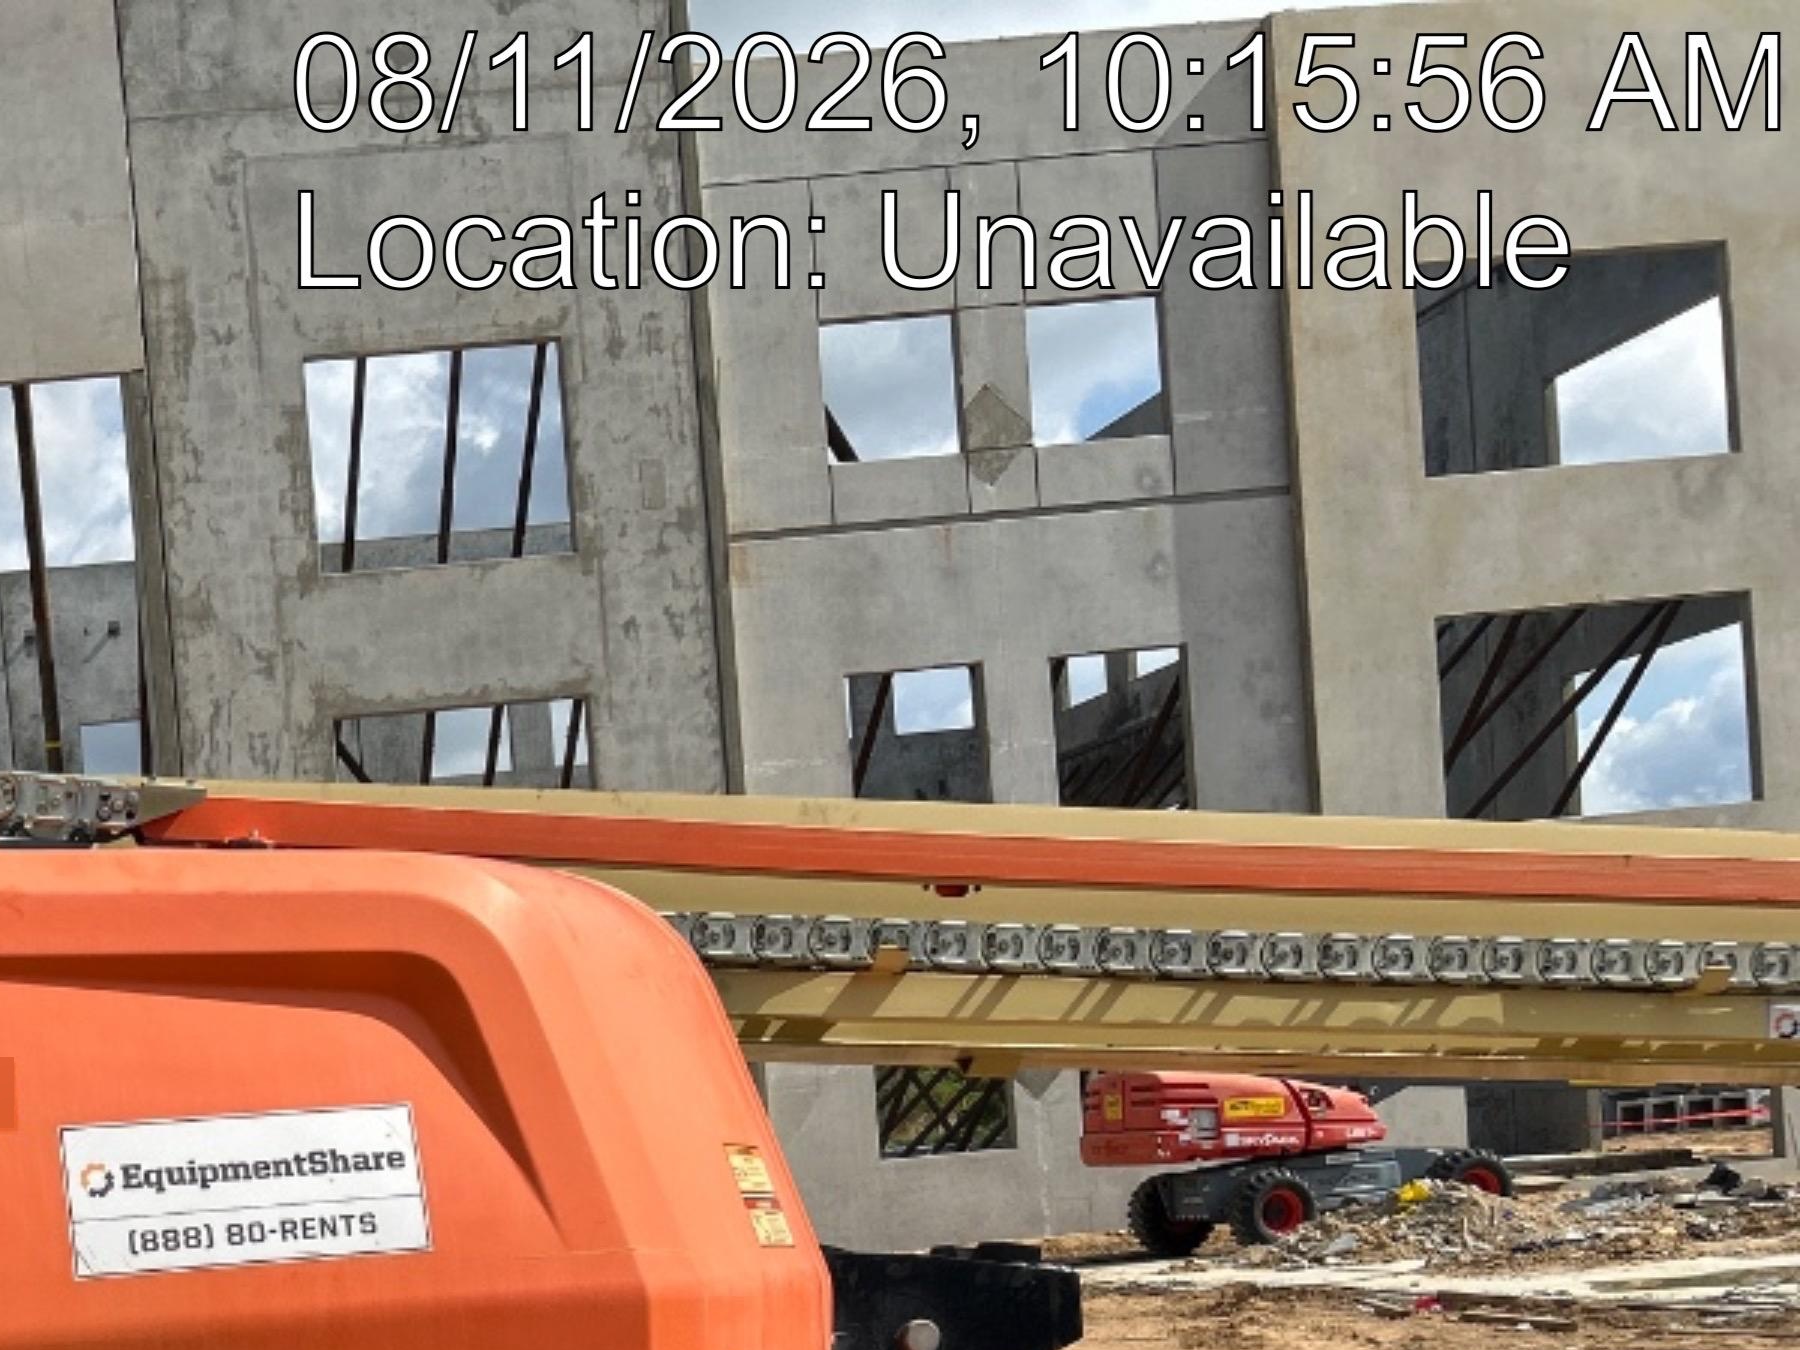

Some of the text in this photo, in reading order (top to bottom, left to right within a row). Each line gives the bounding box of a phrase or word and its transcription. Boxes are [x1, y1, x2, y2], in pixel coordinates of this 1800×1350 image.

[120, 1147, 406, 1193] EquipmentShare
[128, 1211, 379, 1255] (888) 80-RENTS
